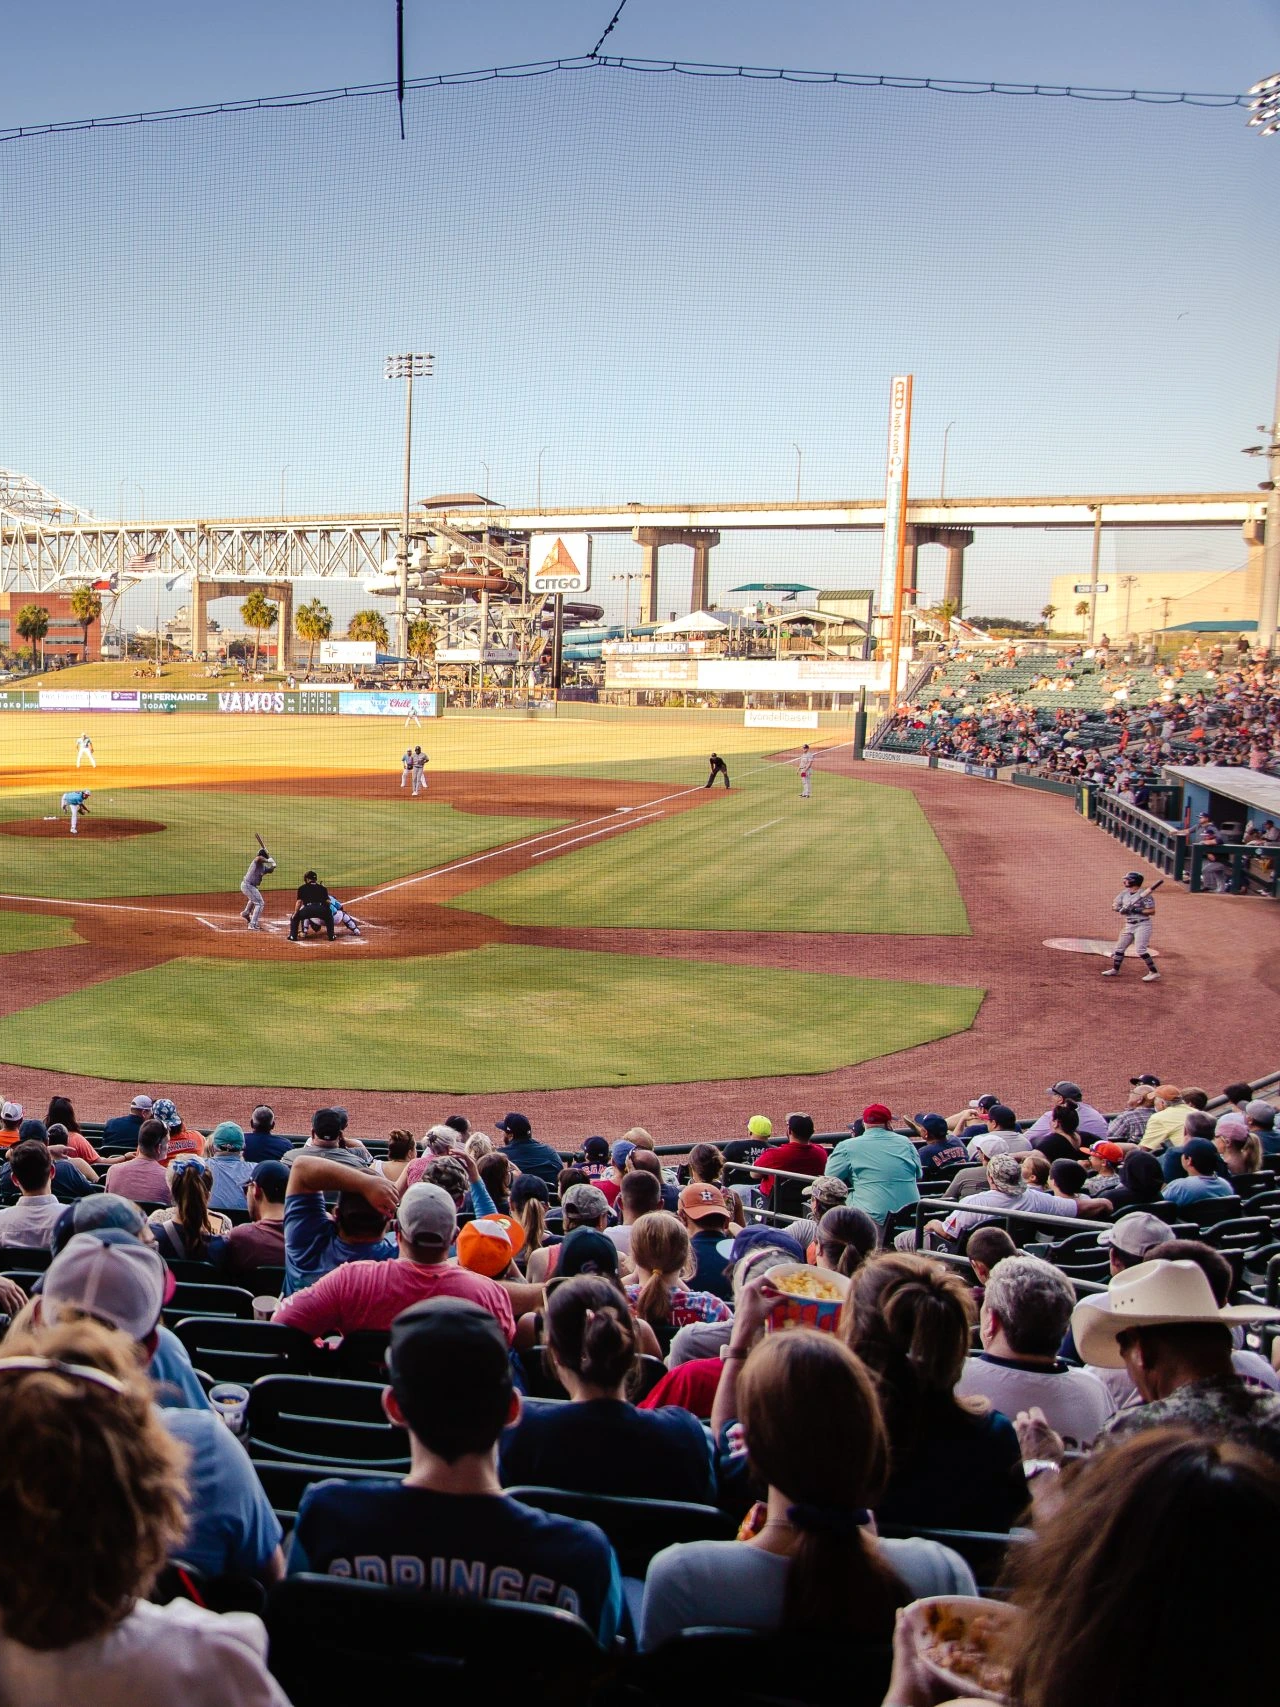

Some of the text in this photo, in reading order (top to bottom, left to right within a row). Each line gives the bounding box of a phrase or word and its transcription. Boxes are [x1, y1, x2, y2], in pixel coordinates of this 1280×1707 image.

[535, 578, 581, 590] CITGO
[153, 693, 208, 701] FERNANDEZ
[219, 692, 285, 712] VAMOS
[389, 698, 412, 708] Chill
[749, 710, 813, 724] lyondellbasell
[870, 751, 897, 762] FERGUSON
[931, 1148, 967, 1167] ALTUVE
